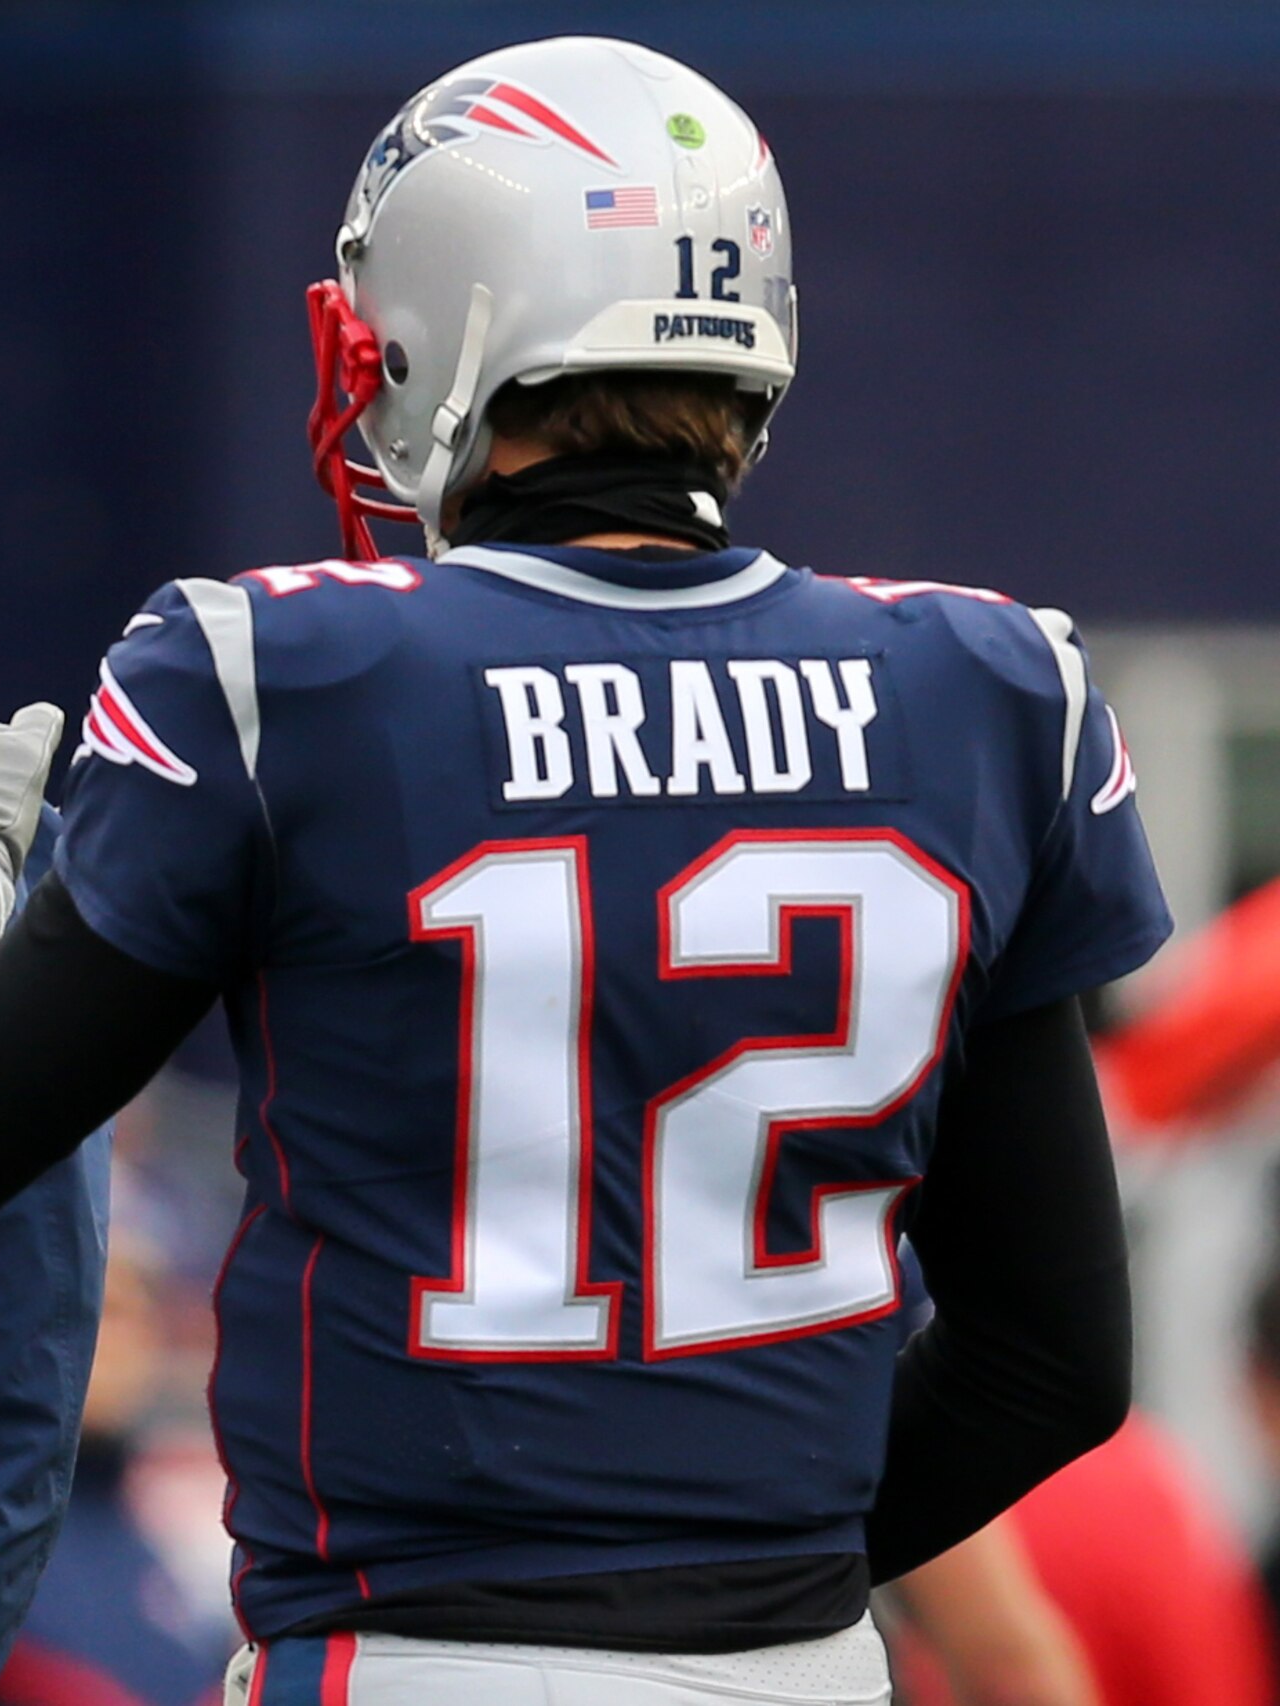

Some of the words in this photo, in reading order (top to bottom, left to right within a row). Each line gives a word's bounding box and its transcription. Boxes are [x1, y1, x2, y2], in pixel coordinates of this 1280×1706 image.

[674, 236, 740, 302] 12
[654, 314, 755, 349] PATRIOTS
[484, 658, 878, 801] BRADY
[407, 826, 972, 1364] 12
